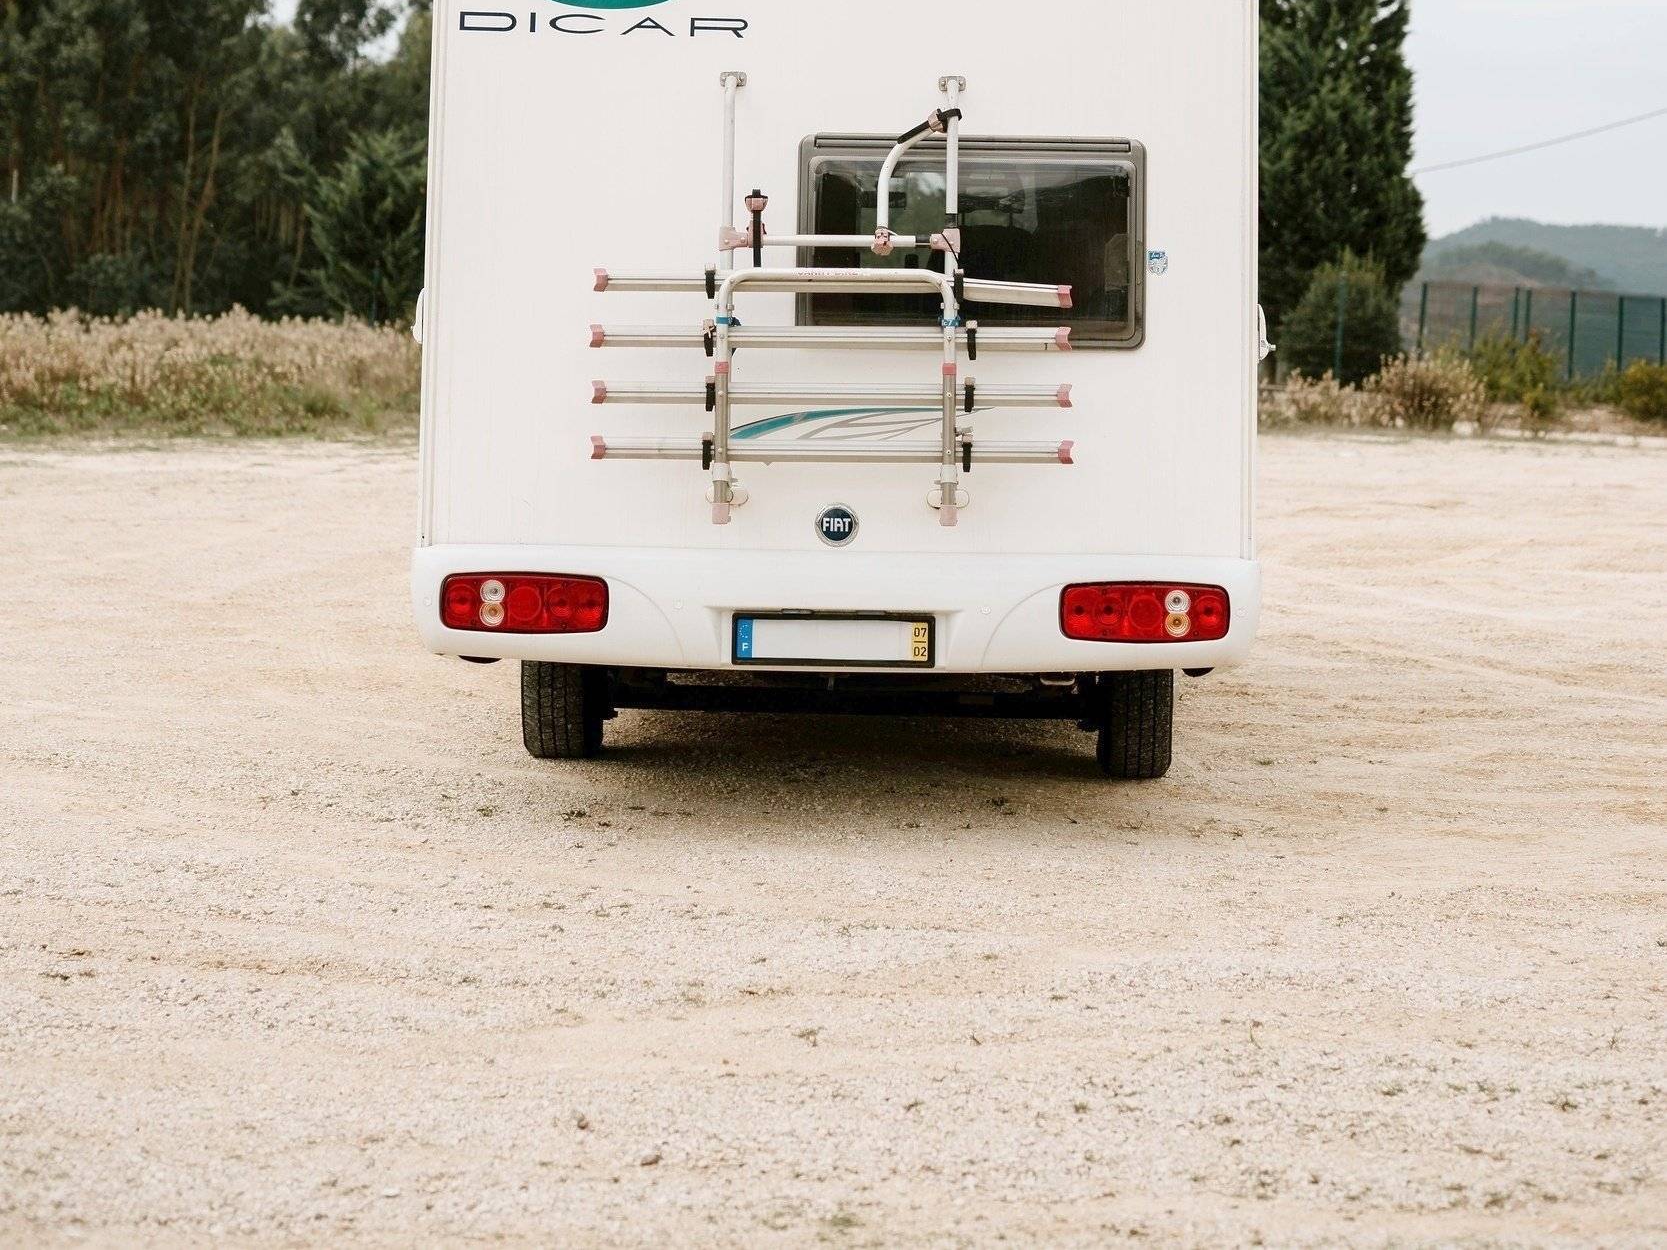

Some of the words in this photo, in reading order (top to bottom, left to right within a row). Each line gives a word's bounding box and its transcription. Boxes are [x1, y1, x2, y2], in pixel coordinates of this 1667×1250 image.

[459, 11, 749, 38] DICAR
[822, 517, 851, 532] FIAT
[913, 627, 927, 638] 07
[913, 646, 927, 657] 02
